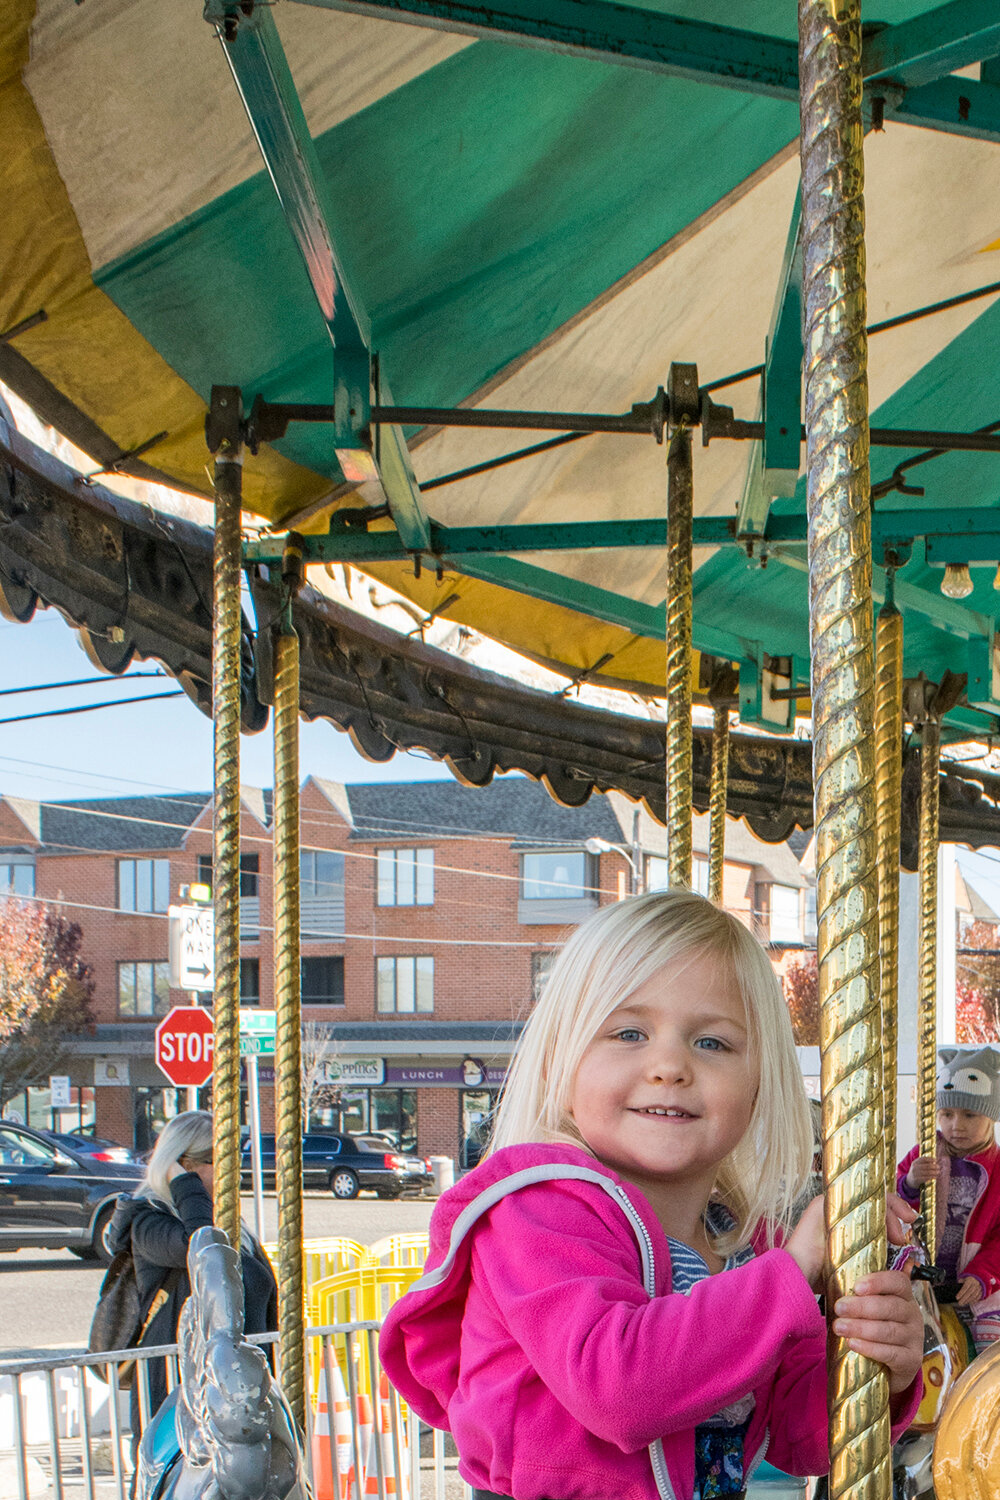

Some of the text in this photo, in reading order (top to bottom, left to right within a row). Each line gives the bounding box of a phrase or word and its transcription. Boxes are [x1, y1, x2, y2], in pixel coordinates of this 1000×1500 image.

[186, 917, 212, 936] ONE
[186, 941, 211, 955] WAY
[161, 1032, 215, 1062] STOP
[402, 1071, 444, 1080] LUNCH
